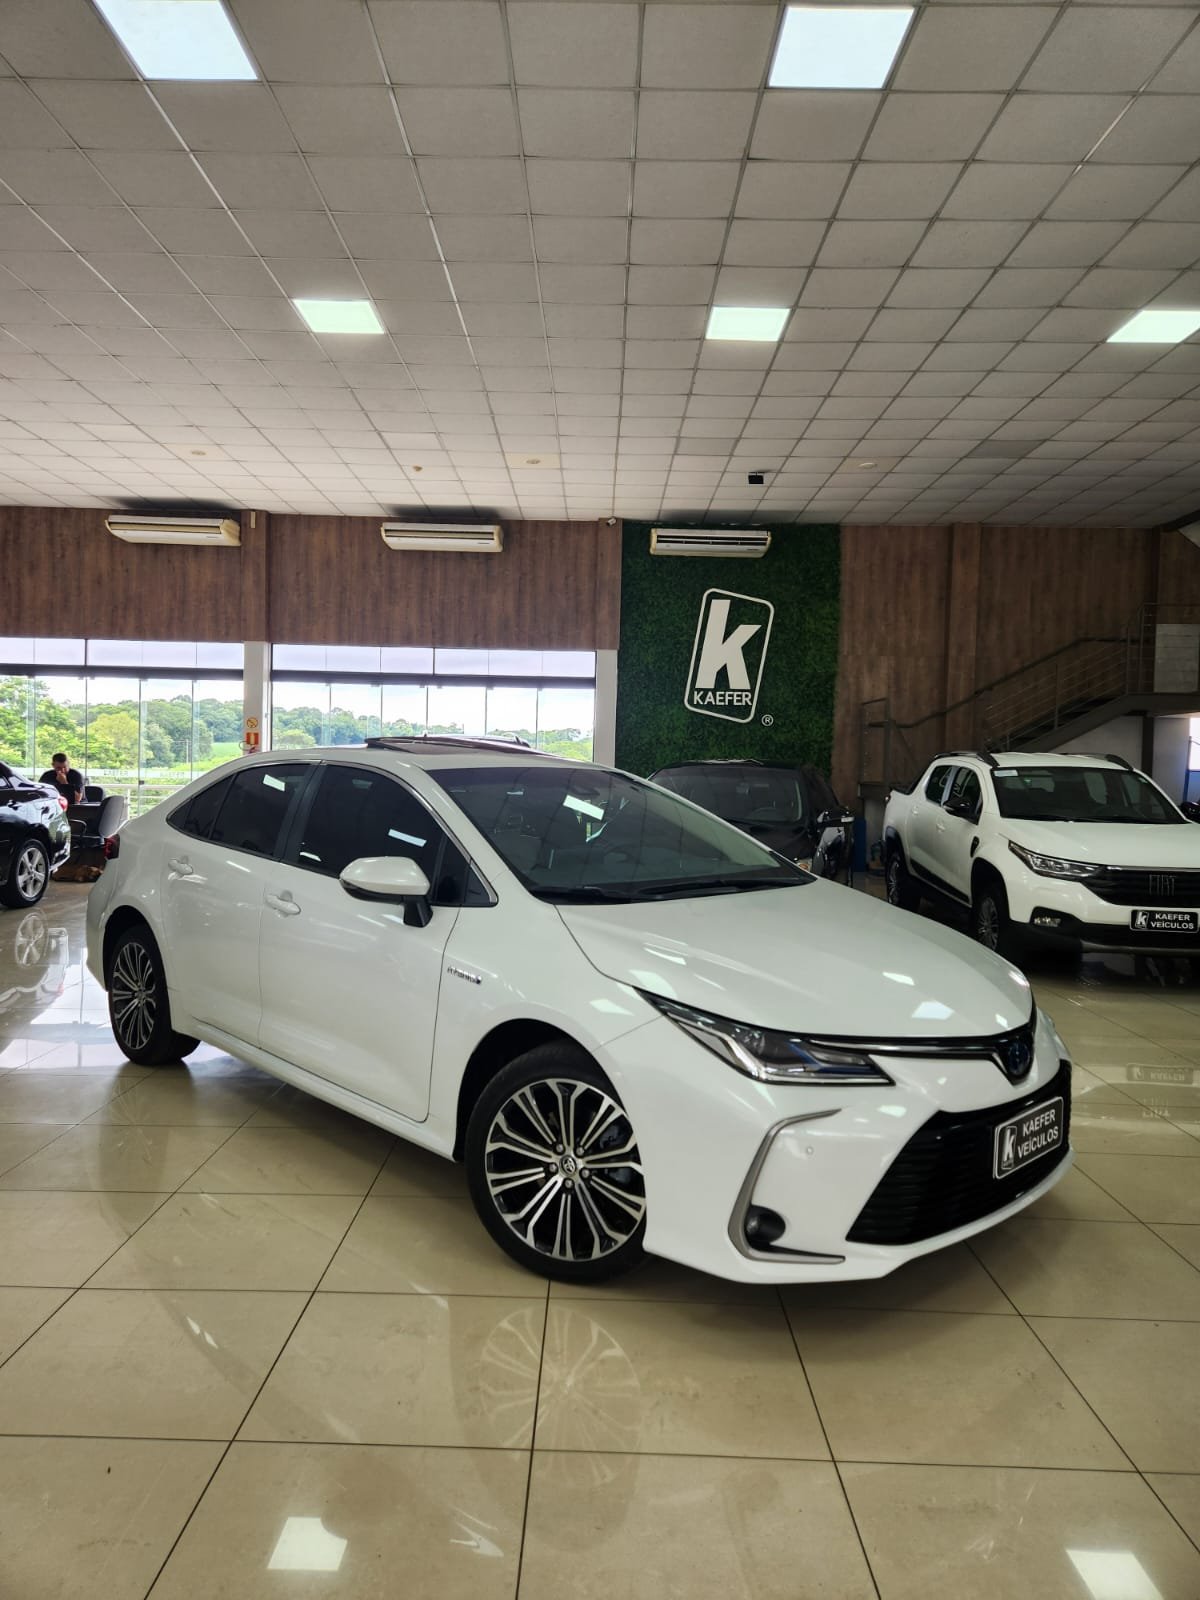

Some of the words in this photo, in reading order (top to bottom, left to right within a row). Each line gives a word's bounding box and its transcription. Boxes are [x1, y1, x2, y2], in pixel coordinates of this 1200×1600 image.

[693, 690, 753, 706] KAEFER
[1155, 913, 1191, 921] KAEFER
[1022, 1109, 1056, 1137] KAEFER
[1017, 1126, 1059, 1159] VEÍCULOS
